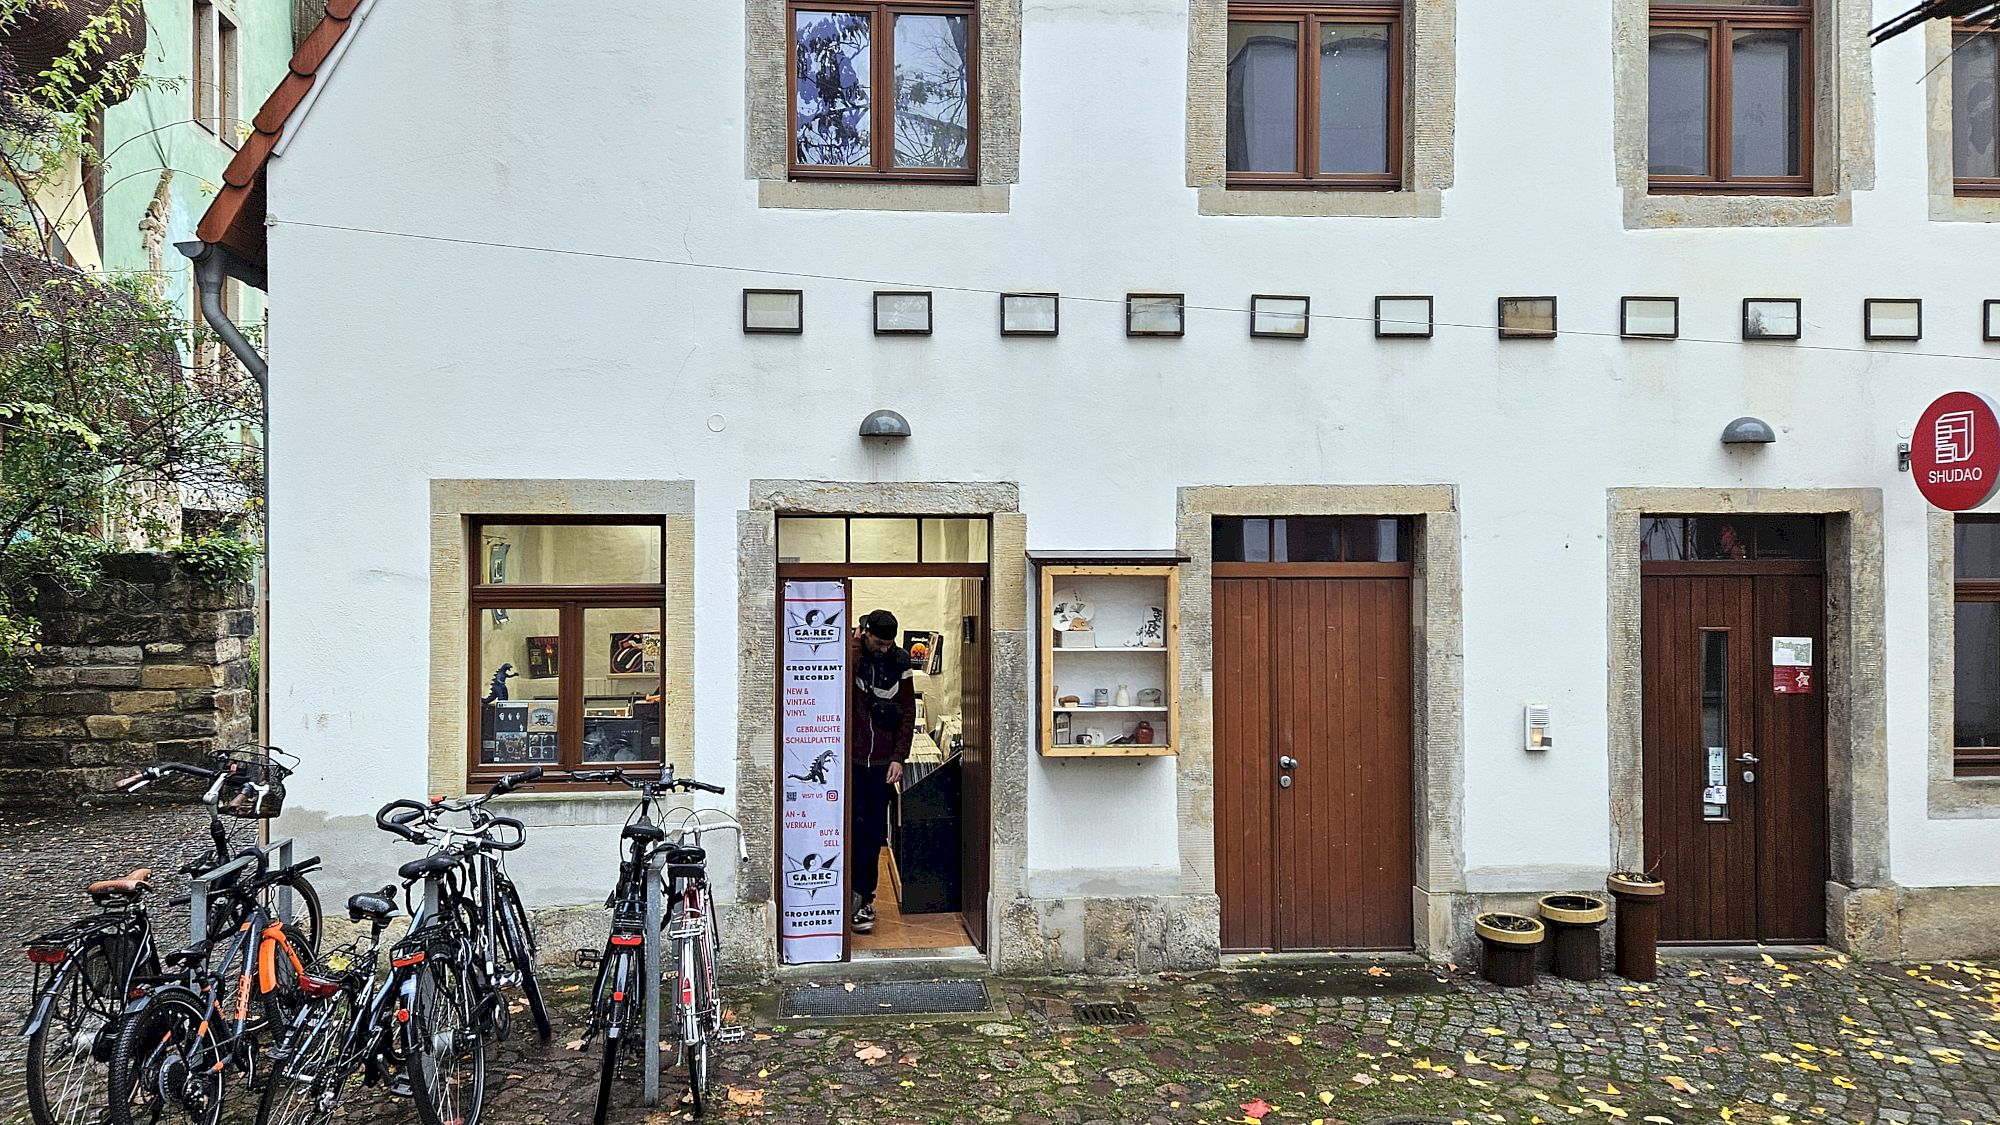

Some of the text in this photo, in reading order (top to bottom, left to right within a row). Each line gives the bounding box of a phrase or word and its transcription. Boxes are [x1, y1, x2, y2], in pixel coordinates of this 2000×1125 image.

[1928, 467, 1982, 484] SHUDAO
[785, 909, 841, 917] GROOVEAMT
[792, 919, 832, 927] RECORDS
